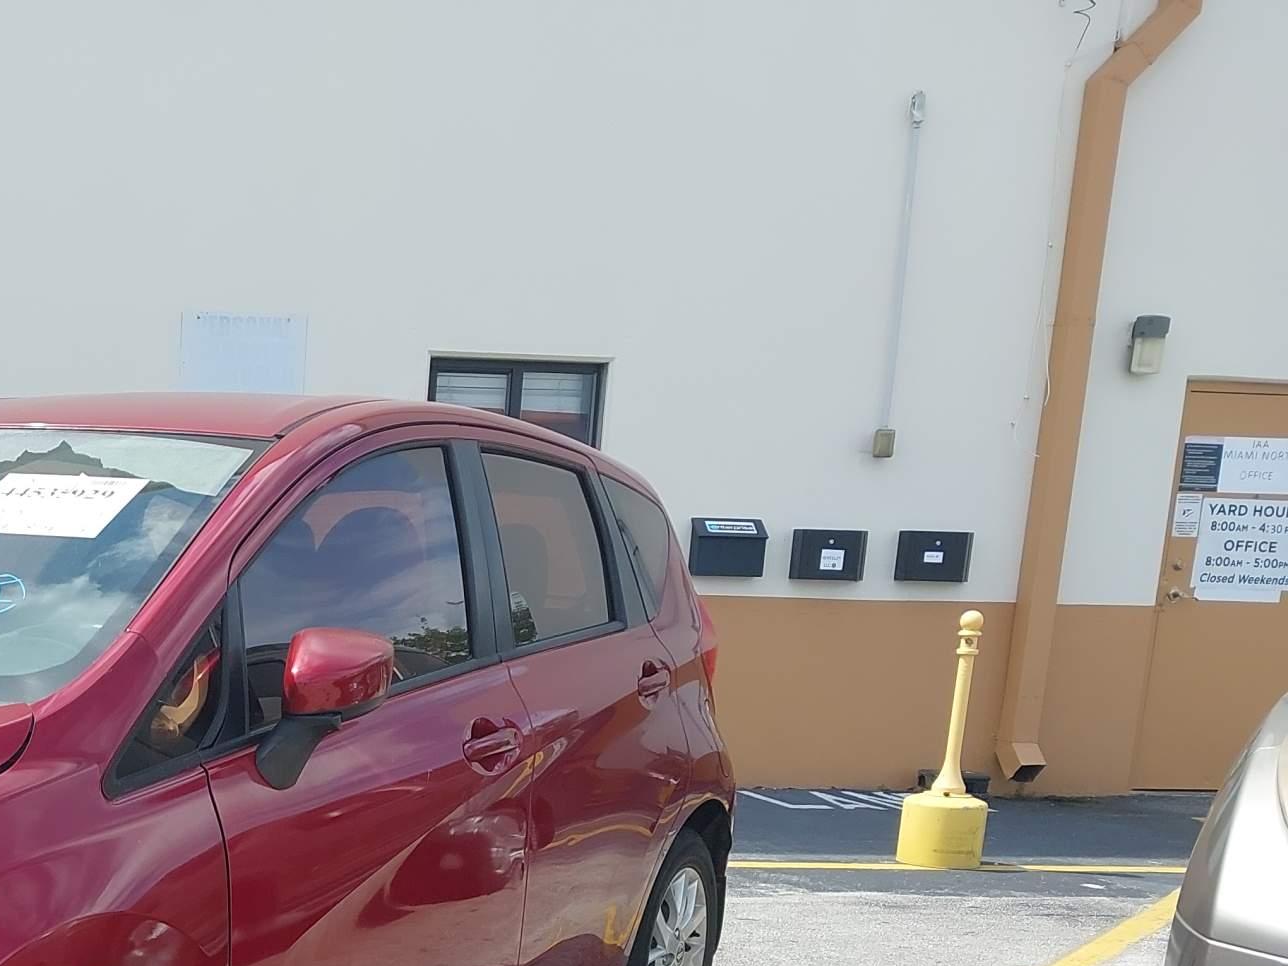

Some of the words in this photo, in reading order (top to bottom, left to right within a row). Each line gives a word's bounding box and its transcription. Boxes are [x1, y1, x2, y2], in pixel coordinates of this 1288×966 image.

[1252, 439, 1270, 449] IAA
[1223, 450, 1258, 460] MIAMI
[1239, 470, 1274, 481] OFFICE
[1209, 503, 1249, 517] YARD
[1210, 520, 1249, 532] 8:00AM
[1259, 522, 1283, 534] 4:30
[1223, 539, 1278, 553] OFFICE
[1205, 556, 1243, 567] 8:00AM
[1199, 572, 1236, 584] Closed
